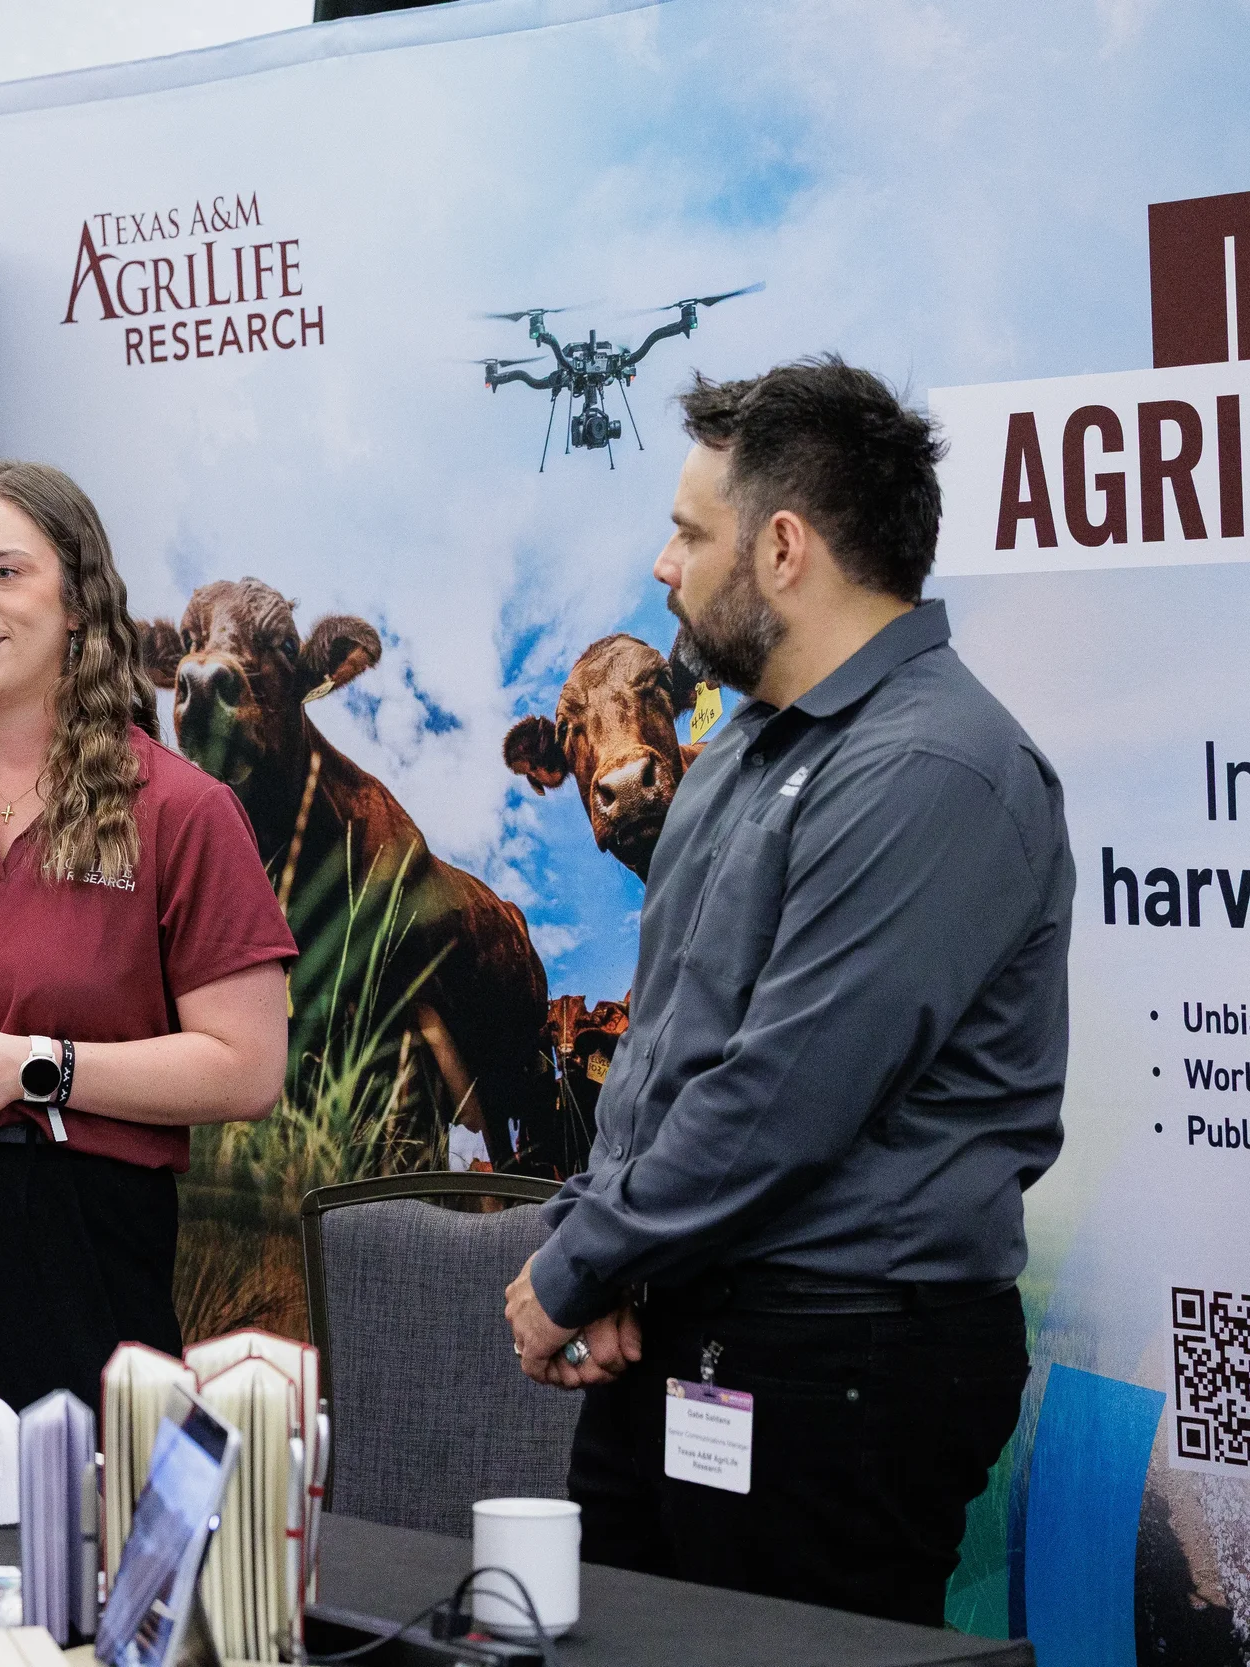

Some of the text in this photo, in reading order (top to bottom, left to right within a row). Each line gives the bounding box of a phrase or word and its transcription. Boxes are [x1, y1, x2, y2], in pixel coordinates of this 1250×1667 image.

[189, 190, 264, 236] A&M
[124, 305, 325, 366] RESEARCH
[995, 393, 1245, 551] AGRI
[66, 871, 136, 892] RSEARCH
[1102, 847, 1250, 929] harv
[692, 1460, 723, 1474] Research
